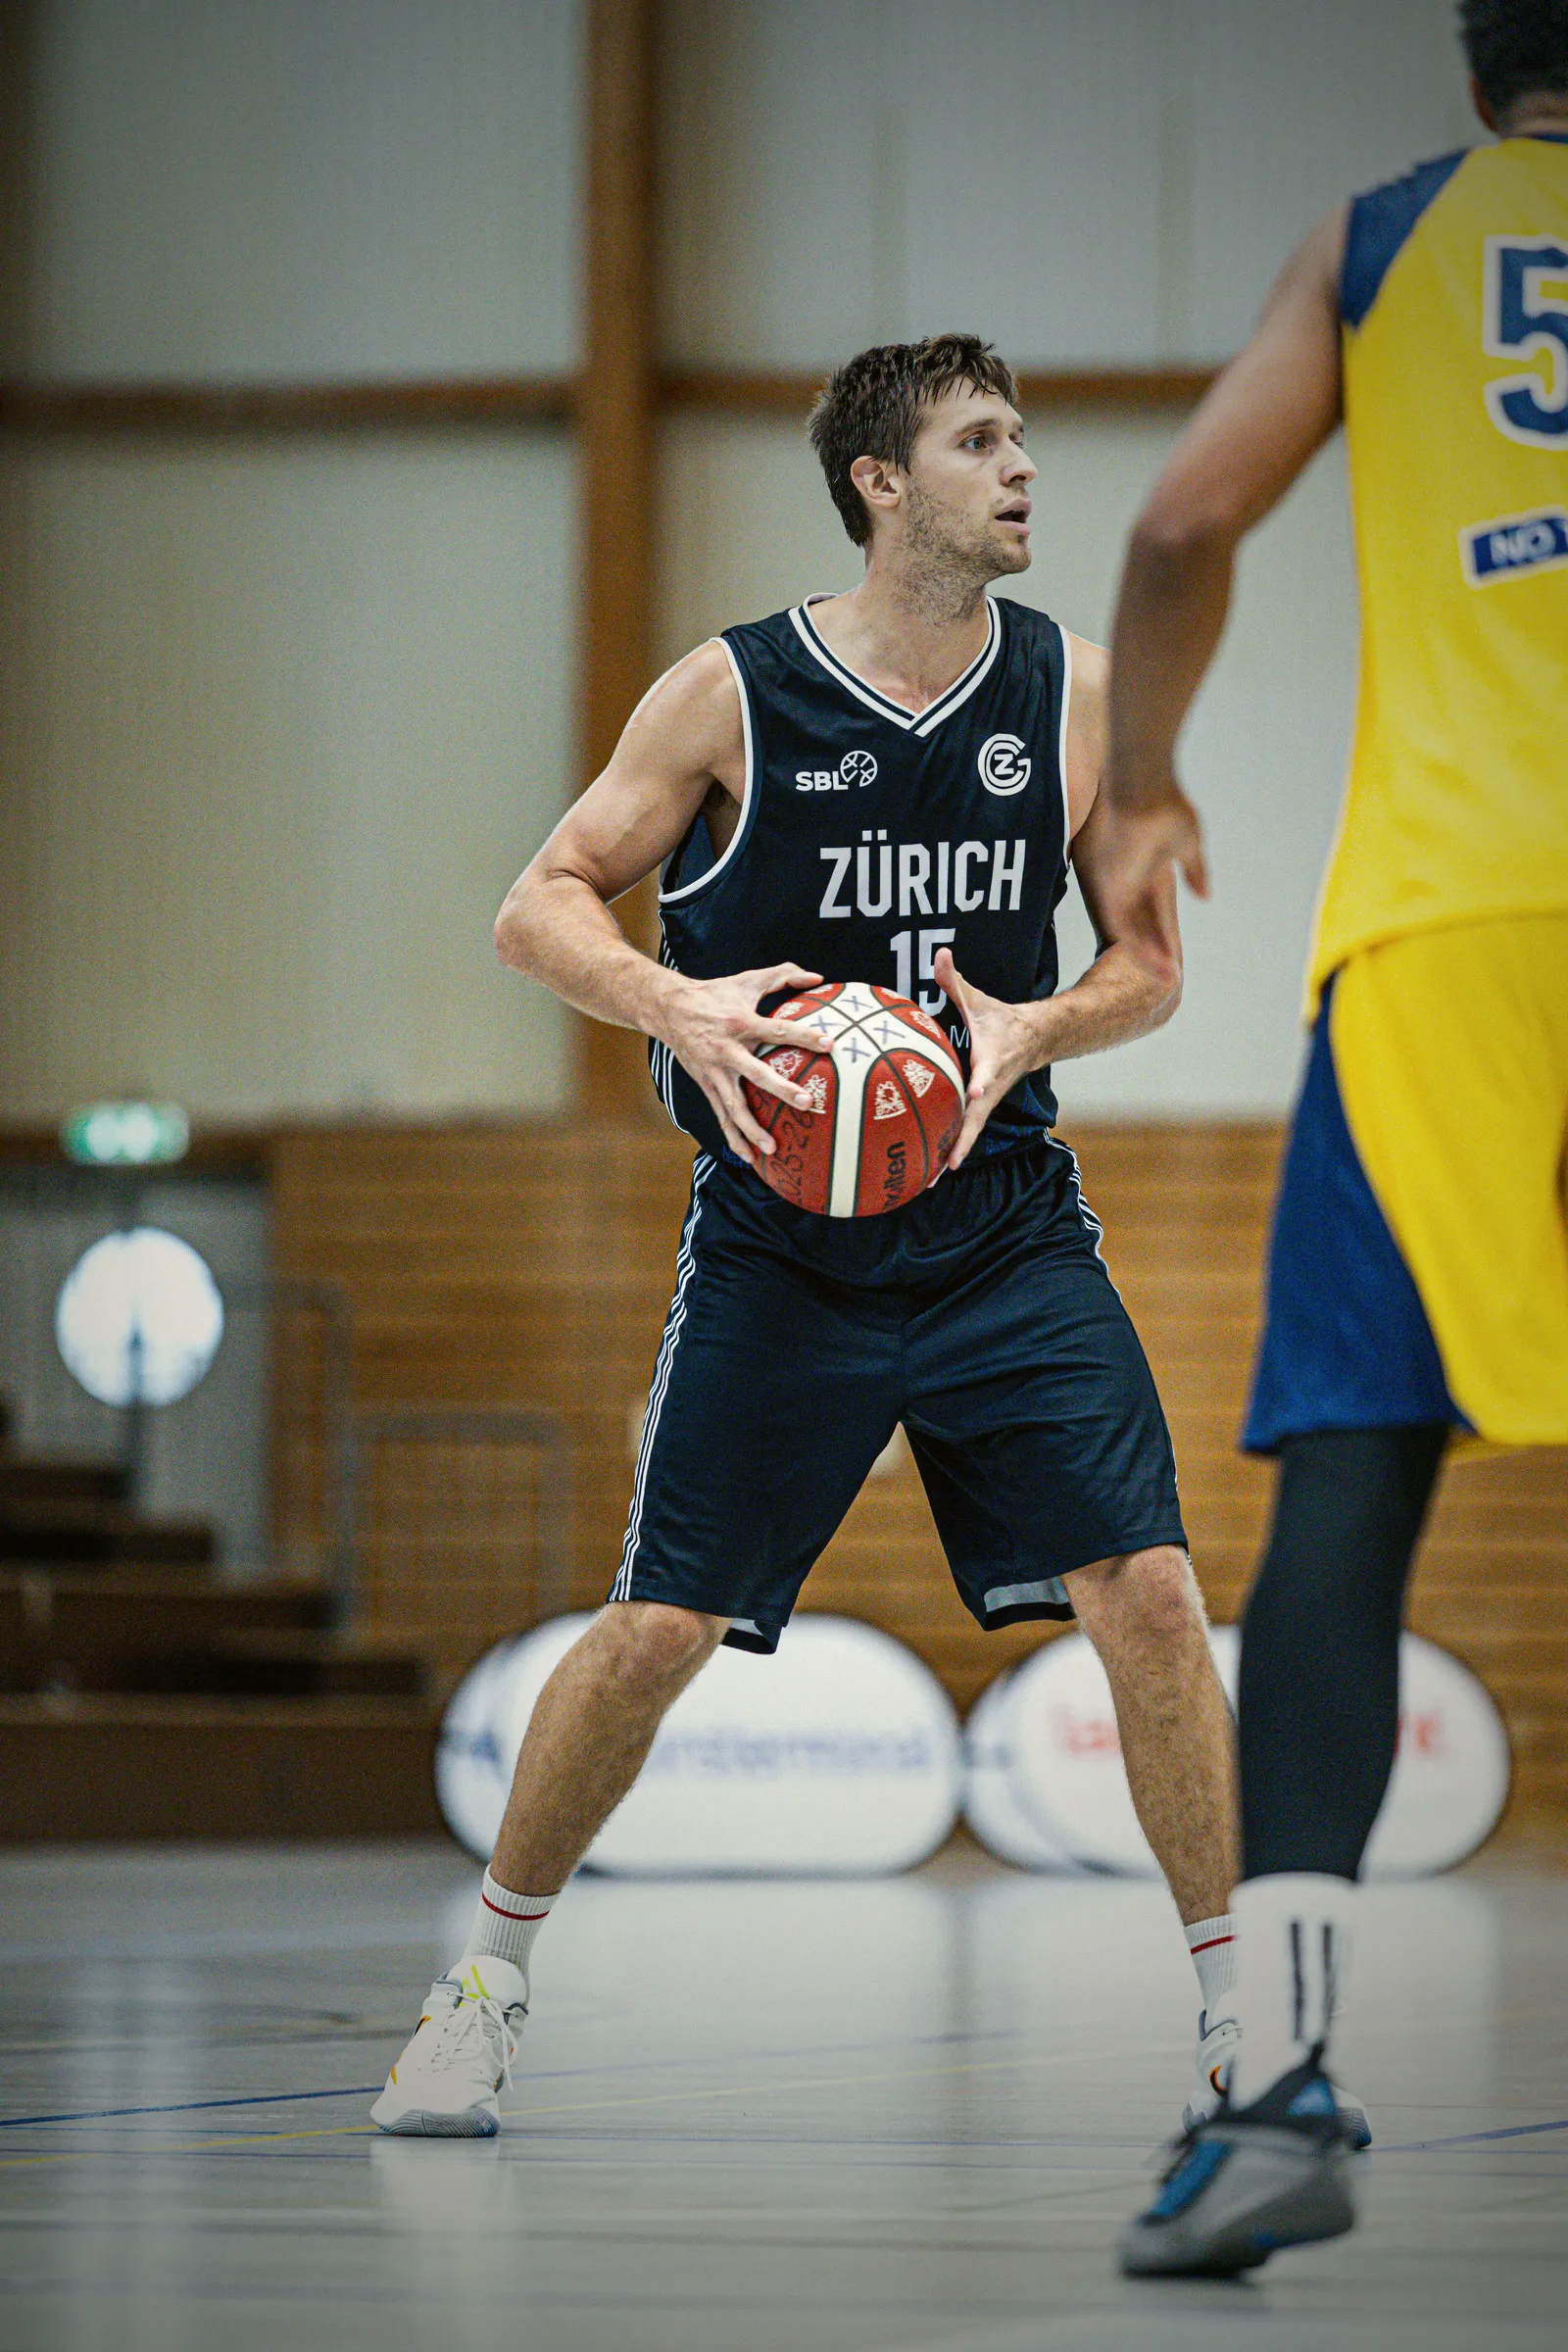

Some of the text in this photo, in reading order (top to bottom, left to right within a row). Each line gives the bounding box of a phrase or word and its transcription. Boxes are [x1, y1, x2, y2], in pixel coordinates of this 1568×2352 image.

[795, 770, 849, 791] SBL
[819, 829, 1026, 919] ZÜRICH
[890, 927, 956, 1017] 15
